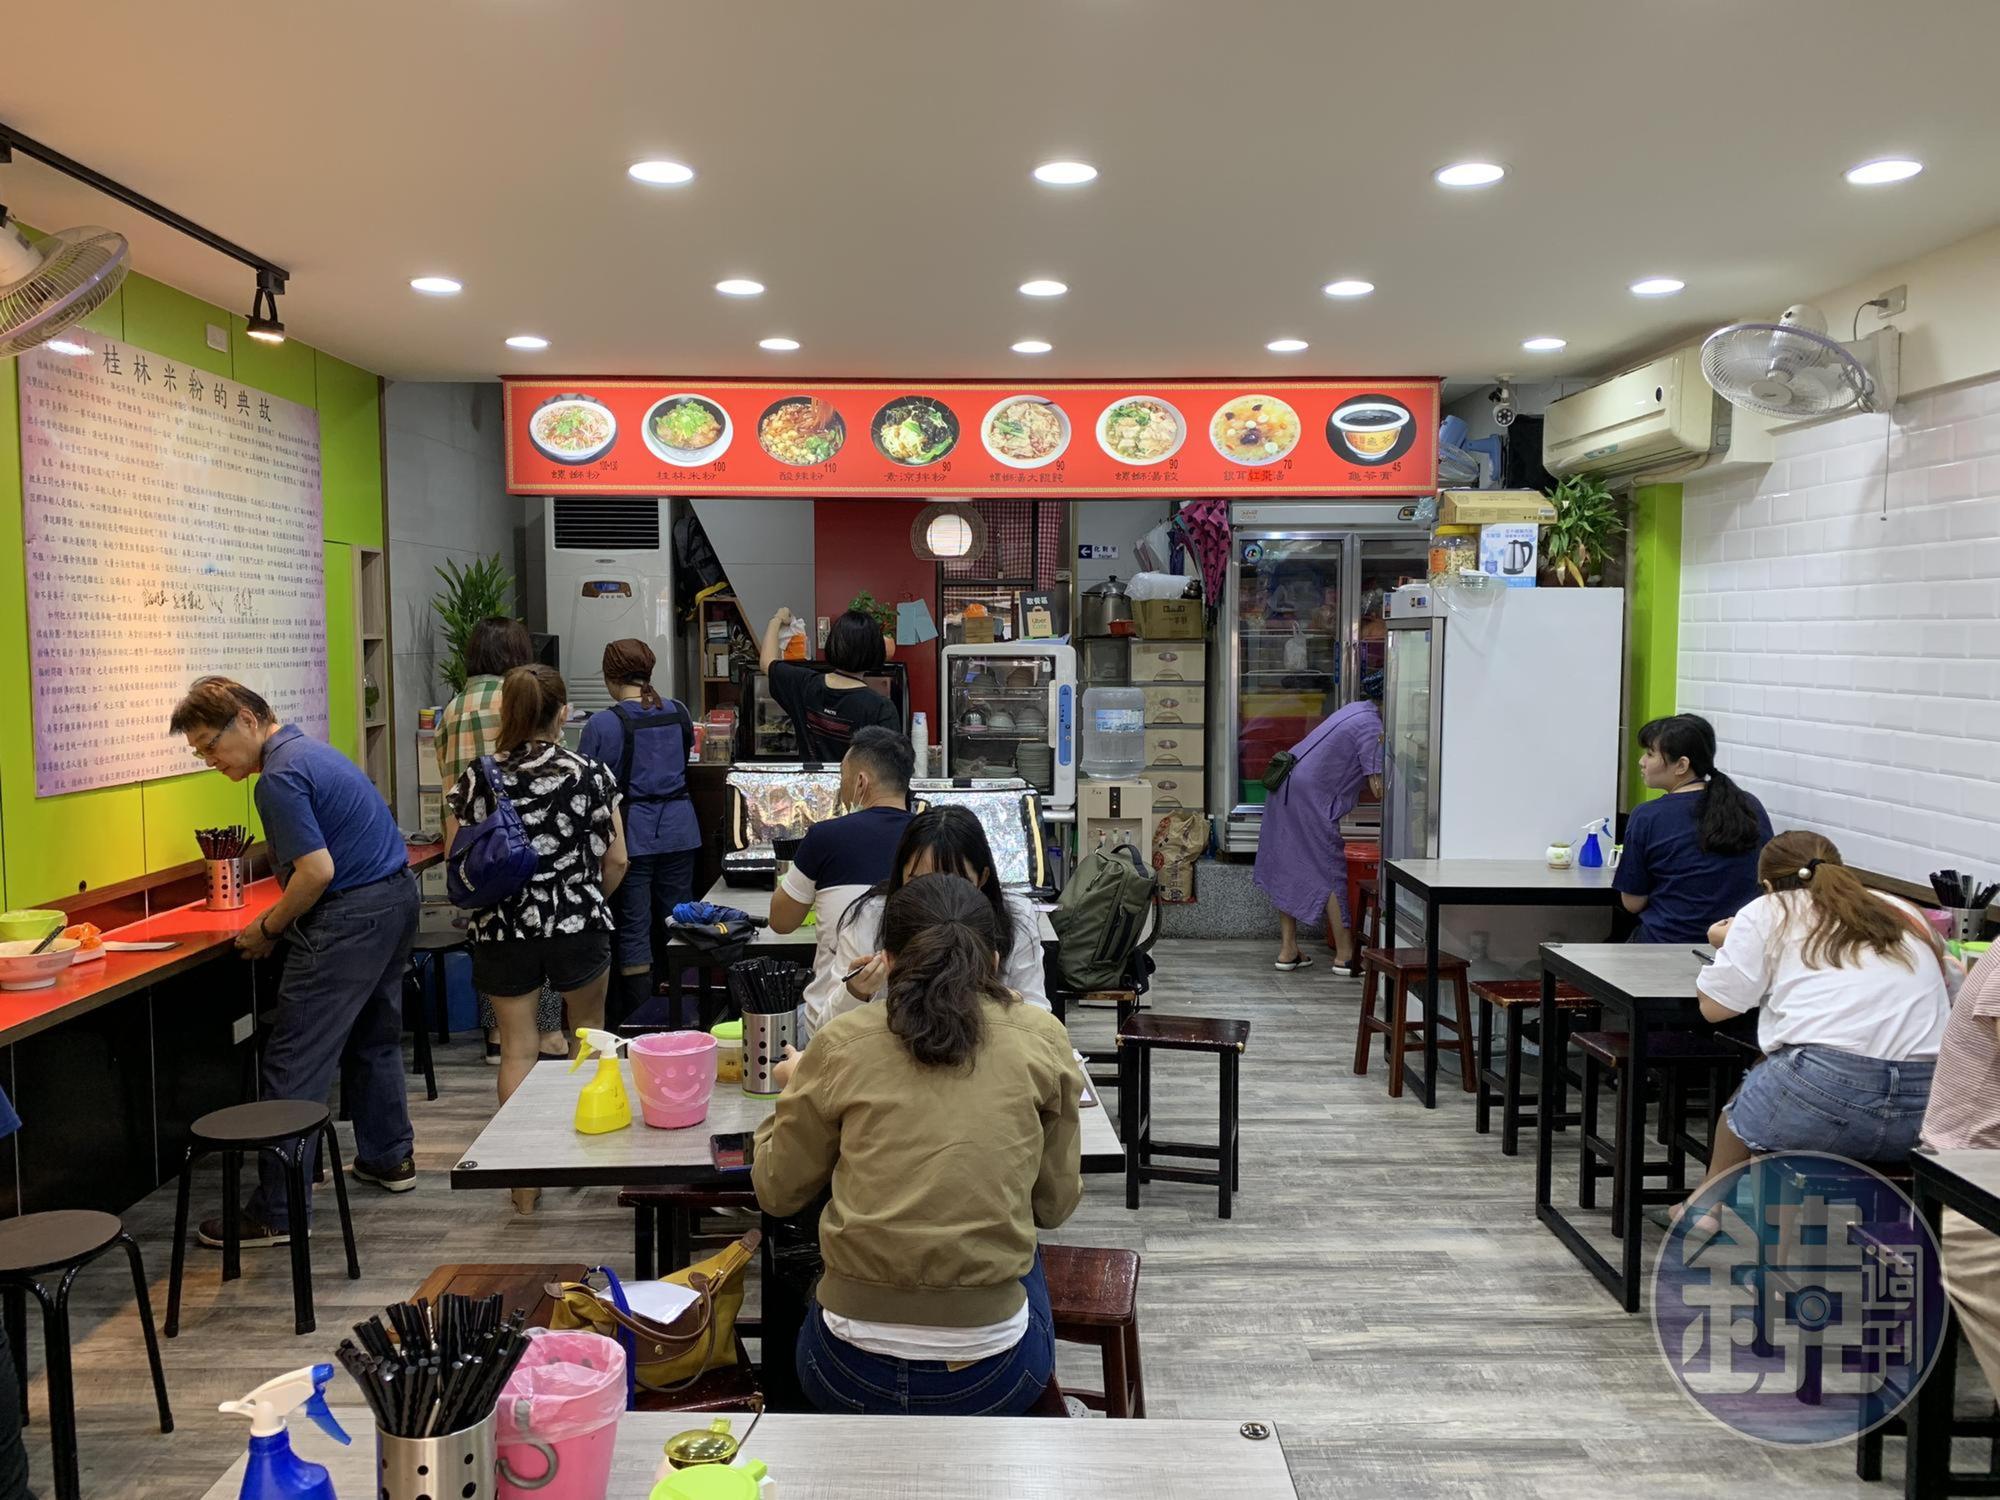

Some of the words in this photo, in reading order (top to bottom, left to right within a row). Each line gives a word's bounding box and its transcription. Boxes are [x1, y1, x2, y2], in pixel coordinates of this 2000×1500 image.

[102, 343, 272, 423] 桂林米粉的典故
[713, 462, 726, 472] 100
[824, 463, 837, 473] 110
[942, 461, 952, 472] 90
[1056, 460, 1065, 471] 90
[1169, 459, 1178, 469] 90
[1284, 459, 1293, 470] 70
[1392, 462, 1402, 472] 45
[657, 471, 717, 481] 桂林米粉
[779, 471, 824, 481] 酸辣粉
